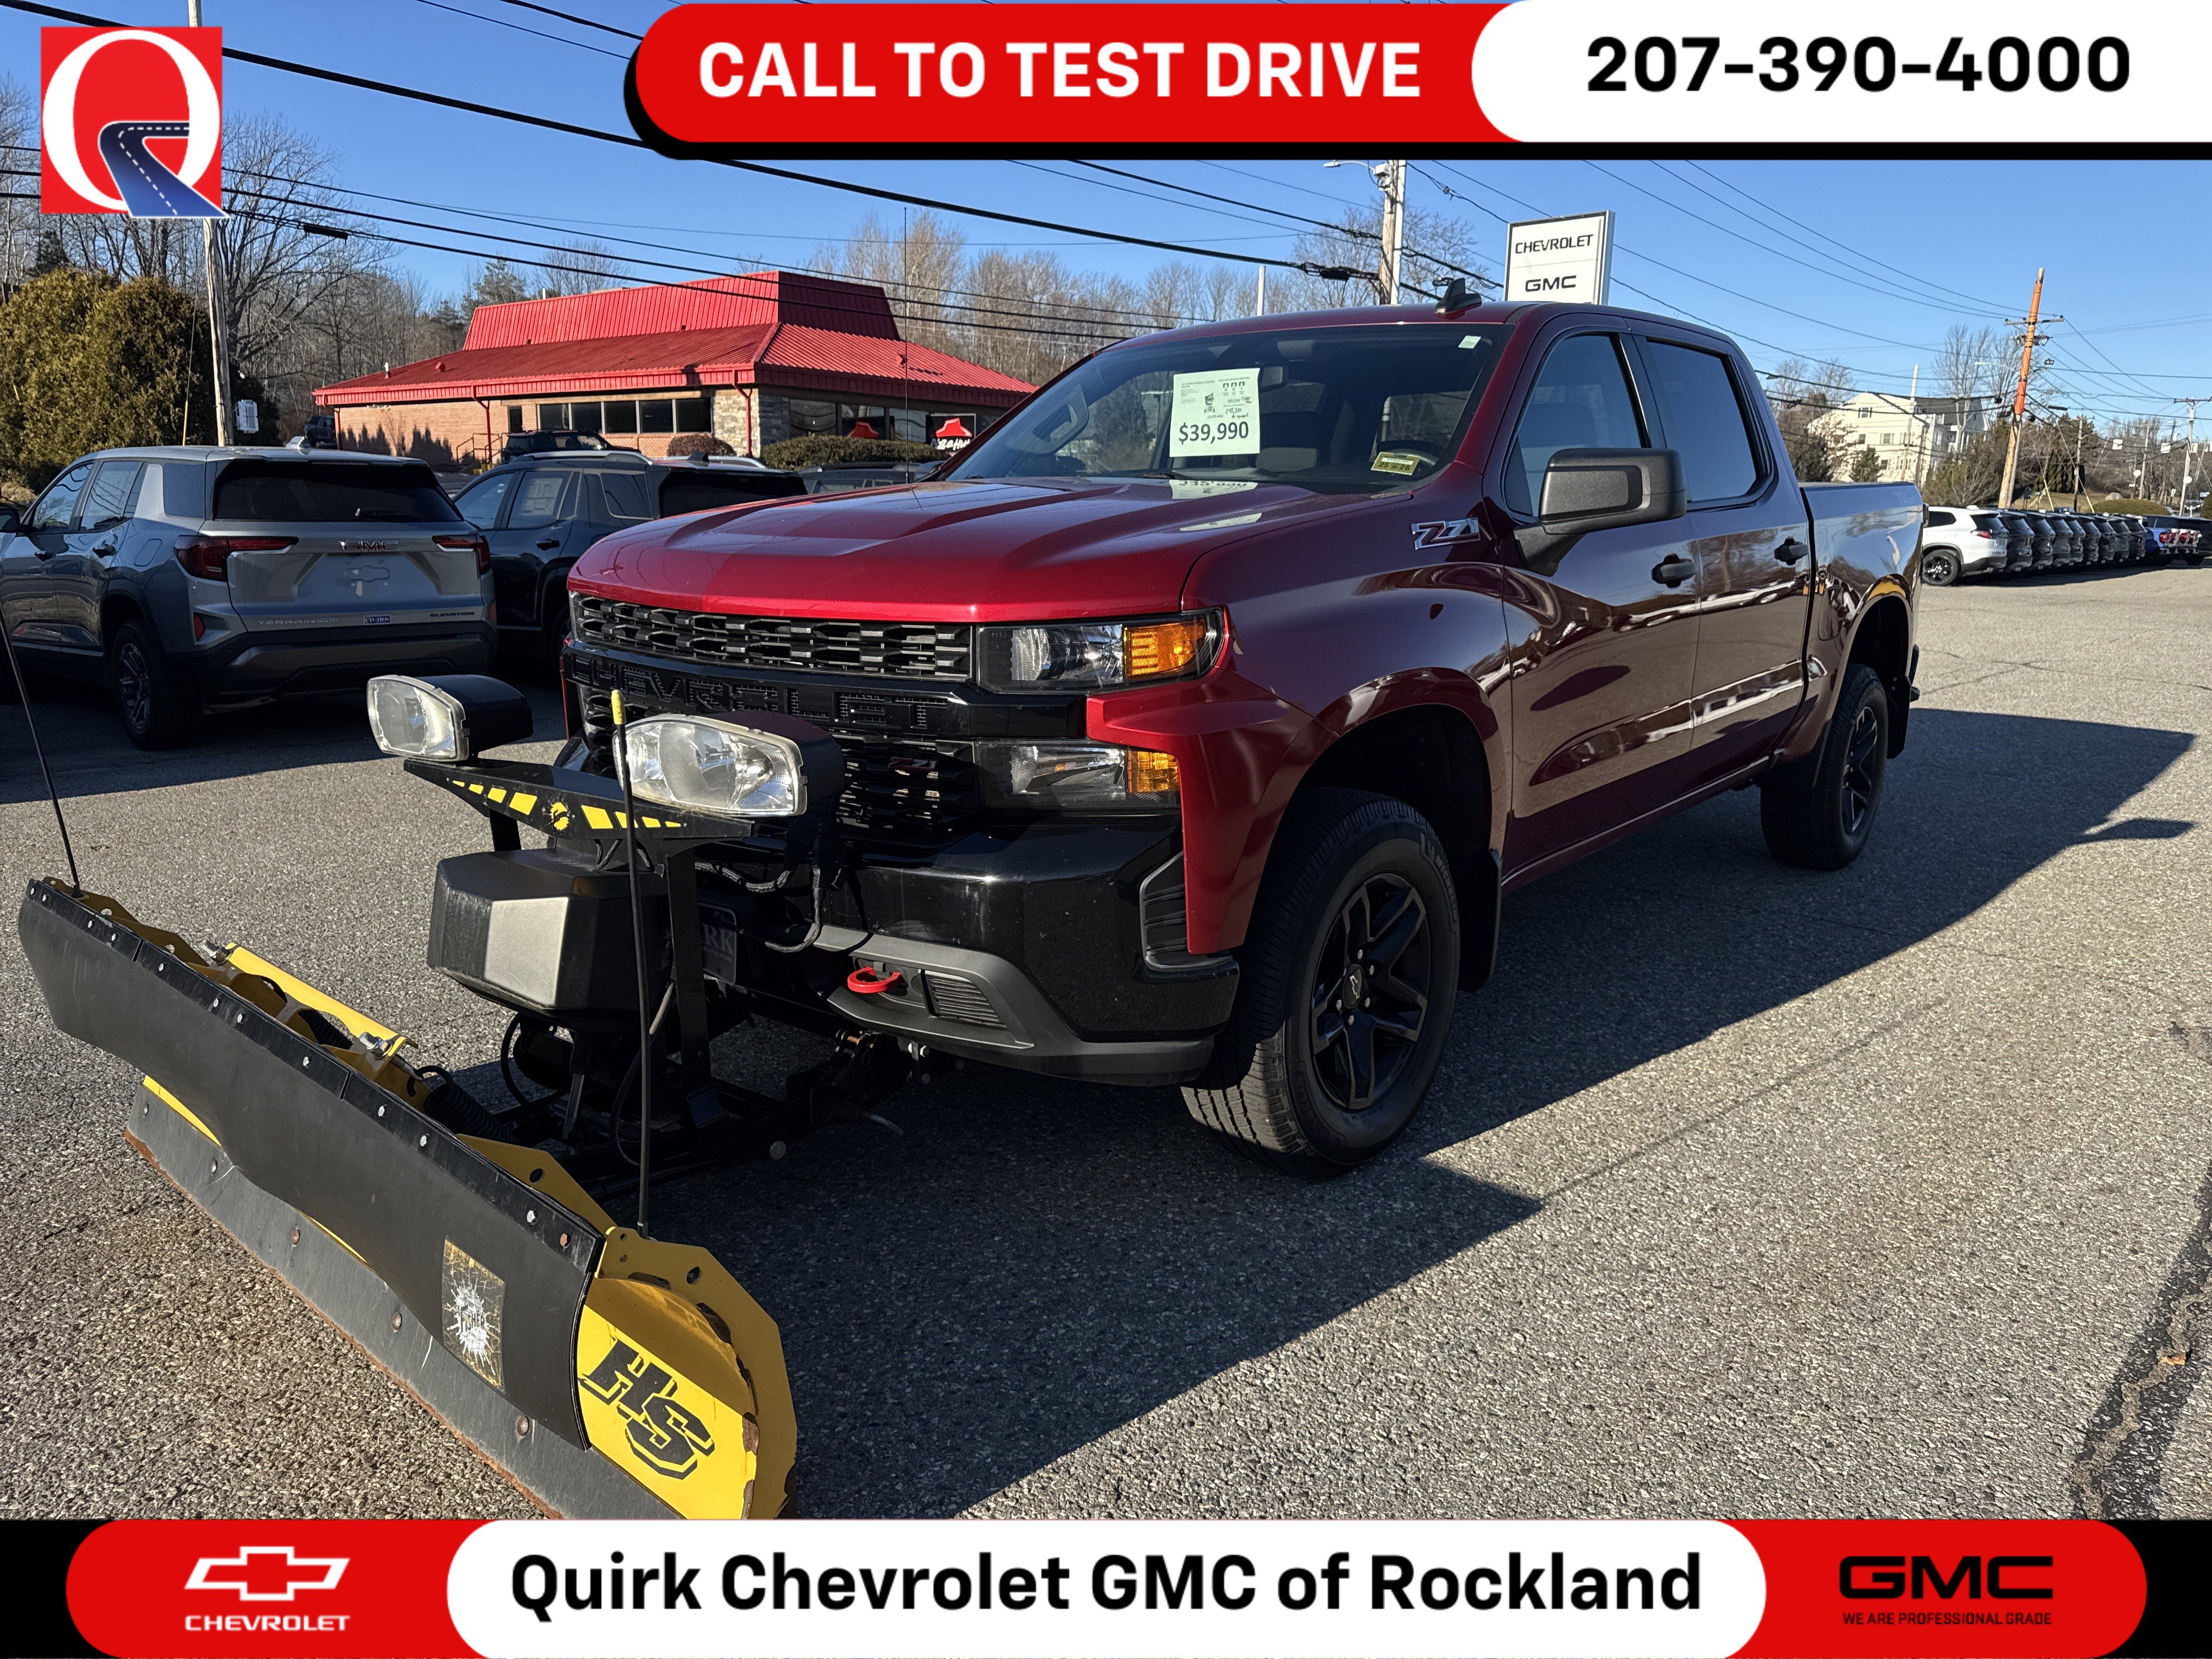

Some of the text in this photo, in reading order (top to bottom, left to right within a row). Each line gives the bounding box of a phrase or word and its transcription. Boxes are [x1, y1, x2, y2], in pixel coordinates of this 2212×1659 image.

[1515, 234, 1594, 254] CHEVROLET
[1525, 274, 1577, 292] GMC
[1178, 421, 1249, 445] $39,990
[1411, 517, 1481, 550] Z71
[340, 540, 399, 552] GMC
[572, 653, 948, 729] CHEVROLET
[888, 756, 938, 772] Z71
